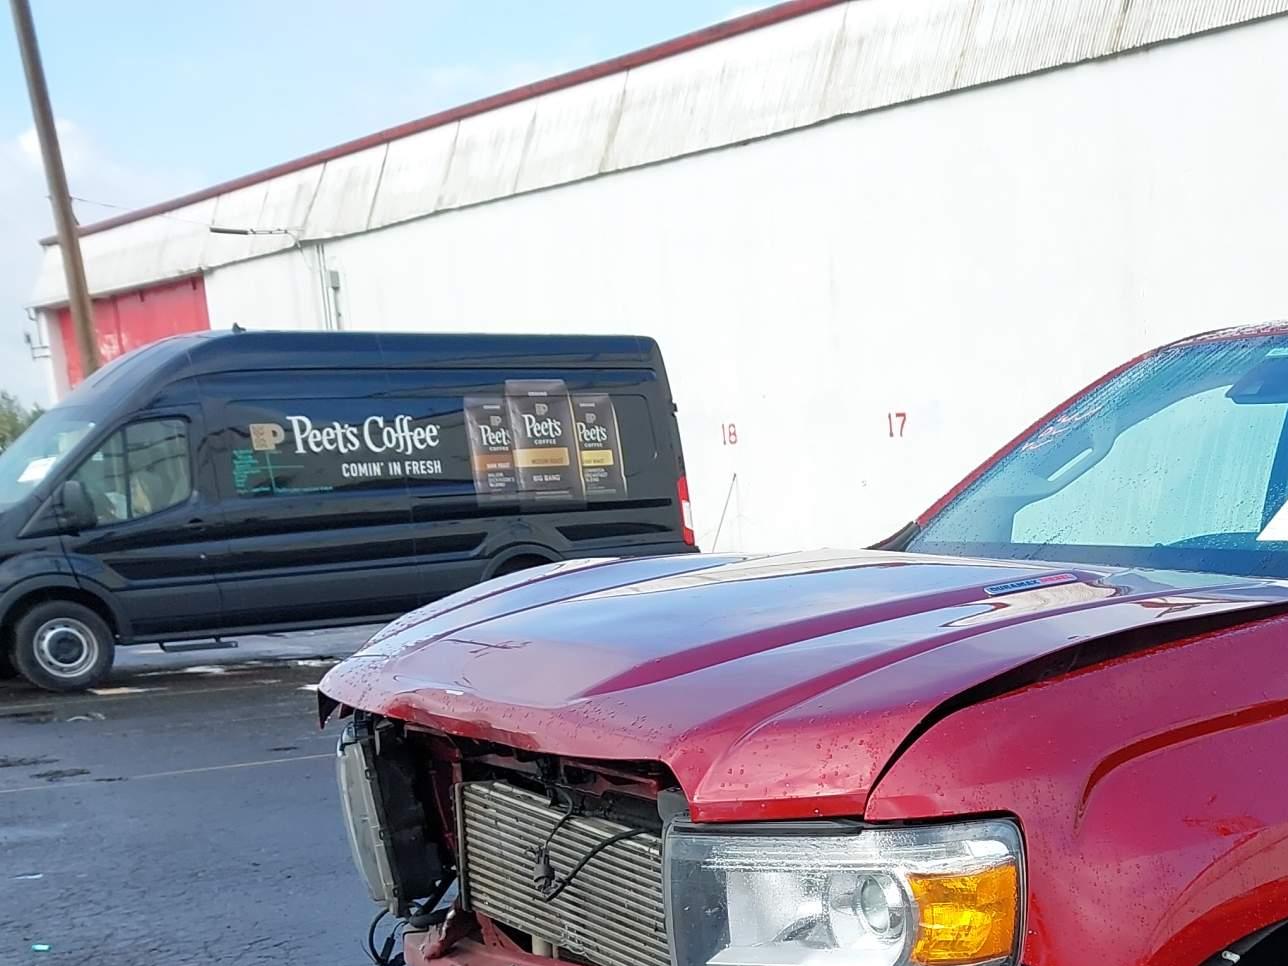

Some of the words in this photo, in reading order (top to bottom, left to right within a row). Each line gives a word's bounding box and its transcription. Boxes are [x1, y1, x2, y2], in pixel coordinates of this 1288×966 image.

[286, 415, 360, 454] Peet's
[363, 415, 440, 455] Coffee
[522, 414, 562, 438] Peet's
[721, 423, 738, 446] 18
[887, 412, 907, 438] 17
[342, 462, 384, 477] COMIN'
[388, 461, 402, 475] IN
[405, 460, 442, 475] FRESH
